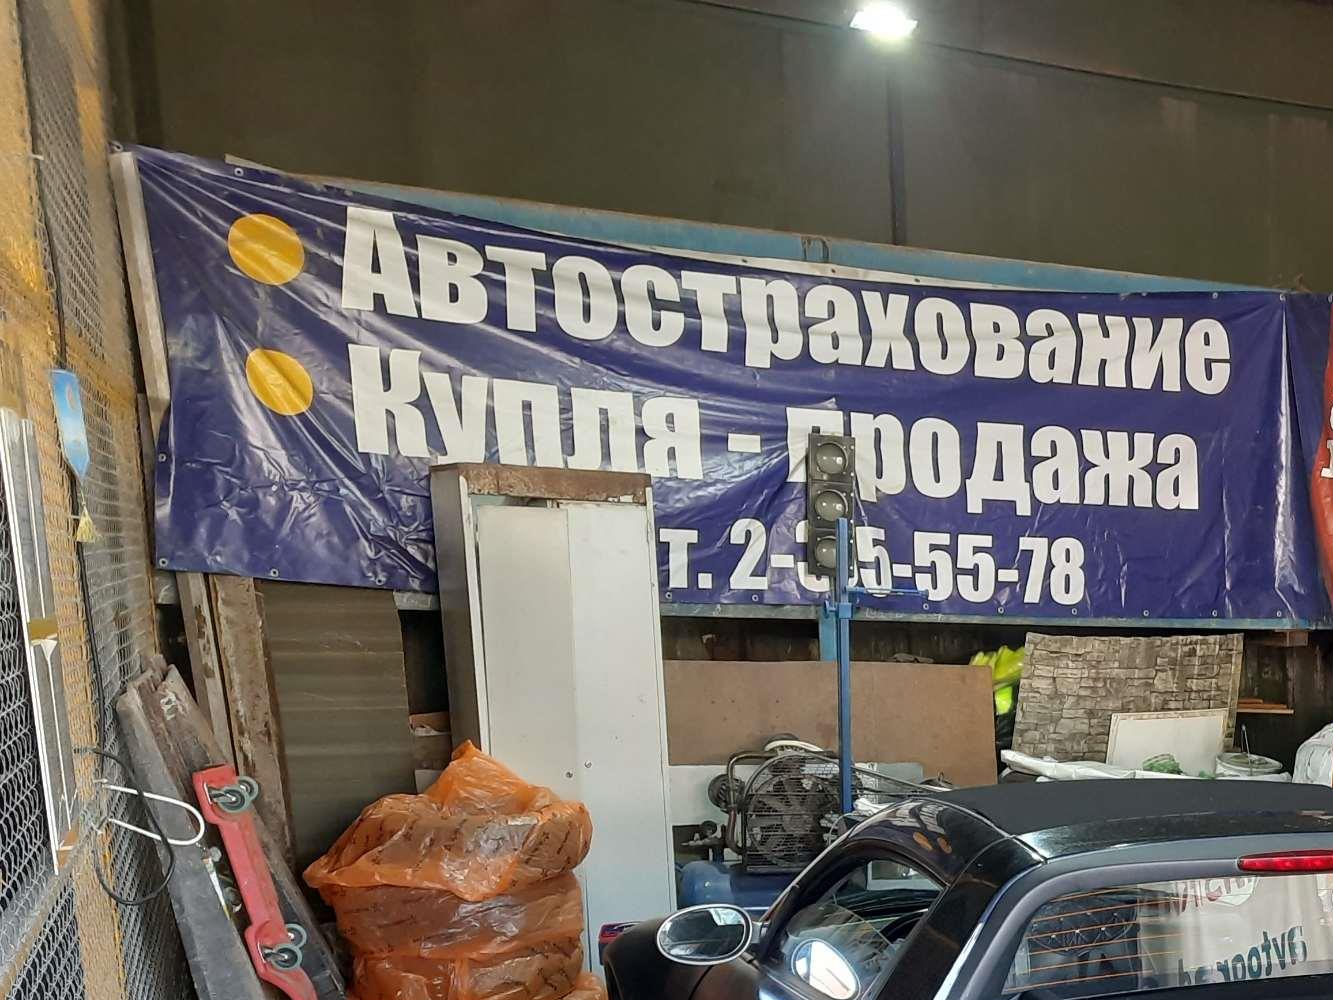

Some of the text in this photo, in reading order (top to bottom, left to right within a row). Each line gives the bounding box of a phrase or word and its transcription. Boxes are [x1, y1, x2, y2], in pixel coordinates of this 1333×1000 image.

[341, 205, 1232, 395] Автострахование
[348, 343, 703, 480] Купля
[659, 518, 1085, 604] т. 2-5-55-78
